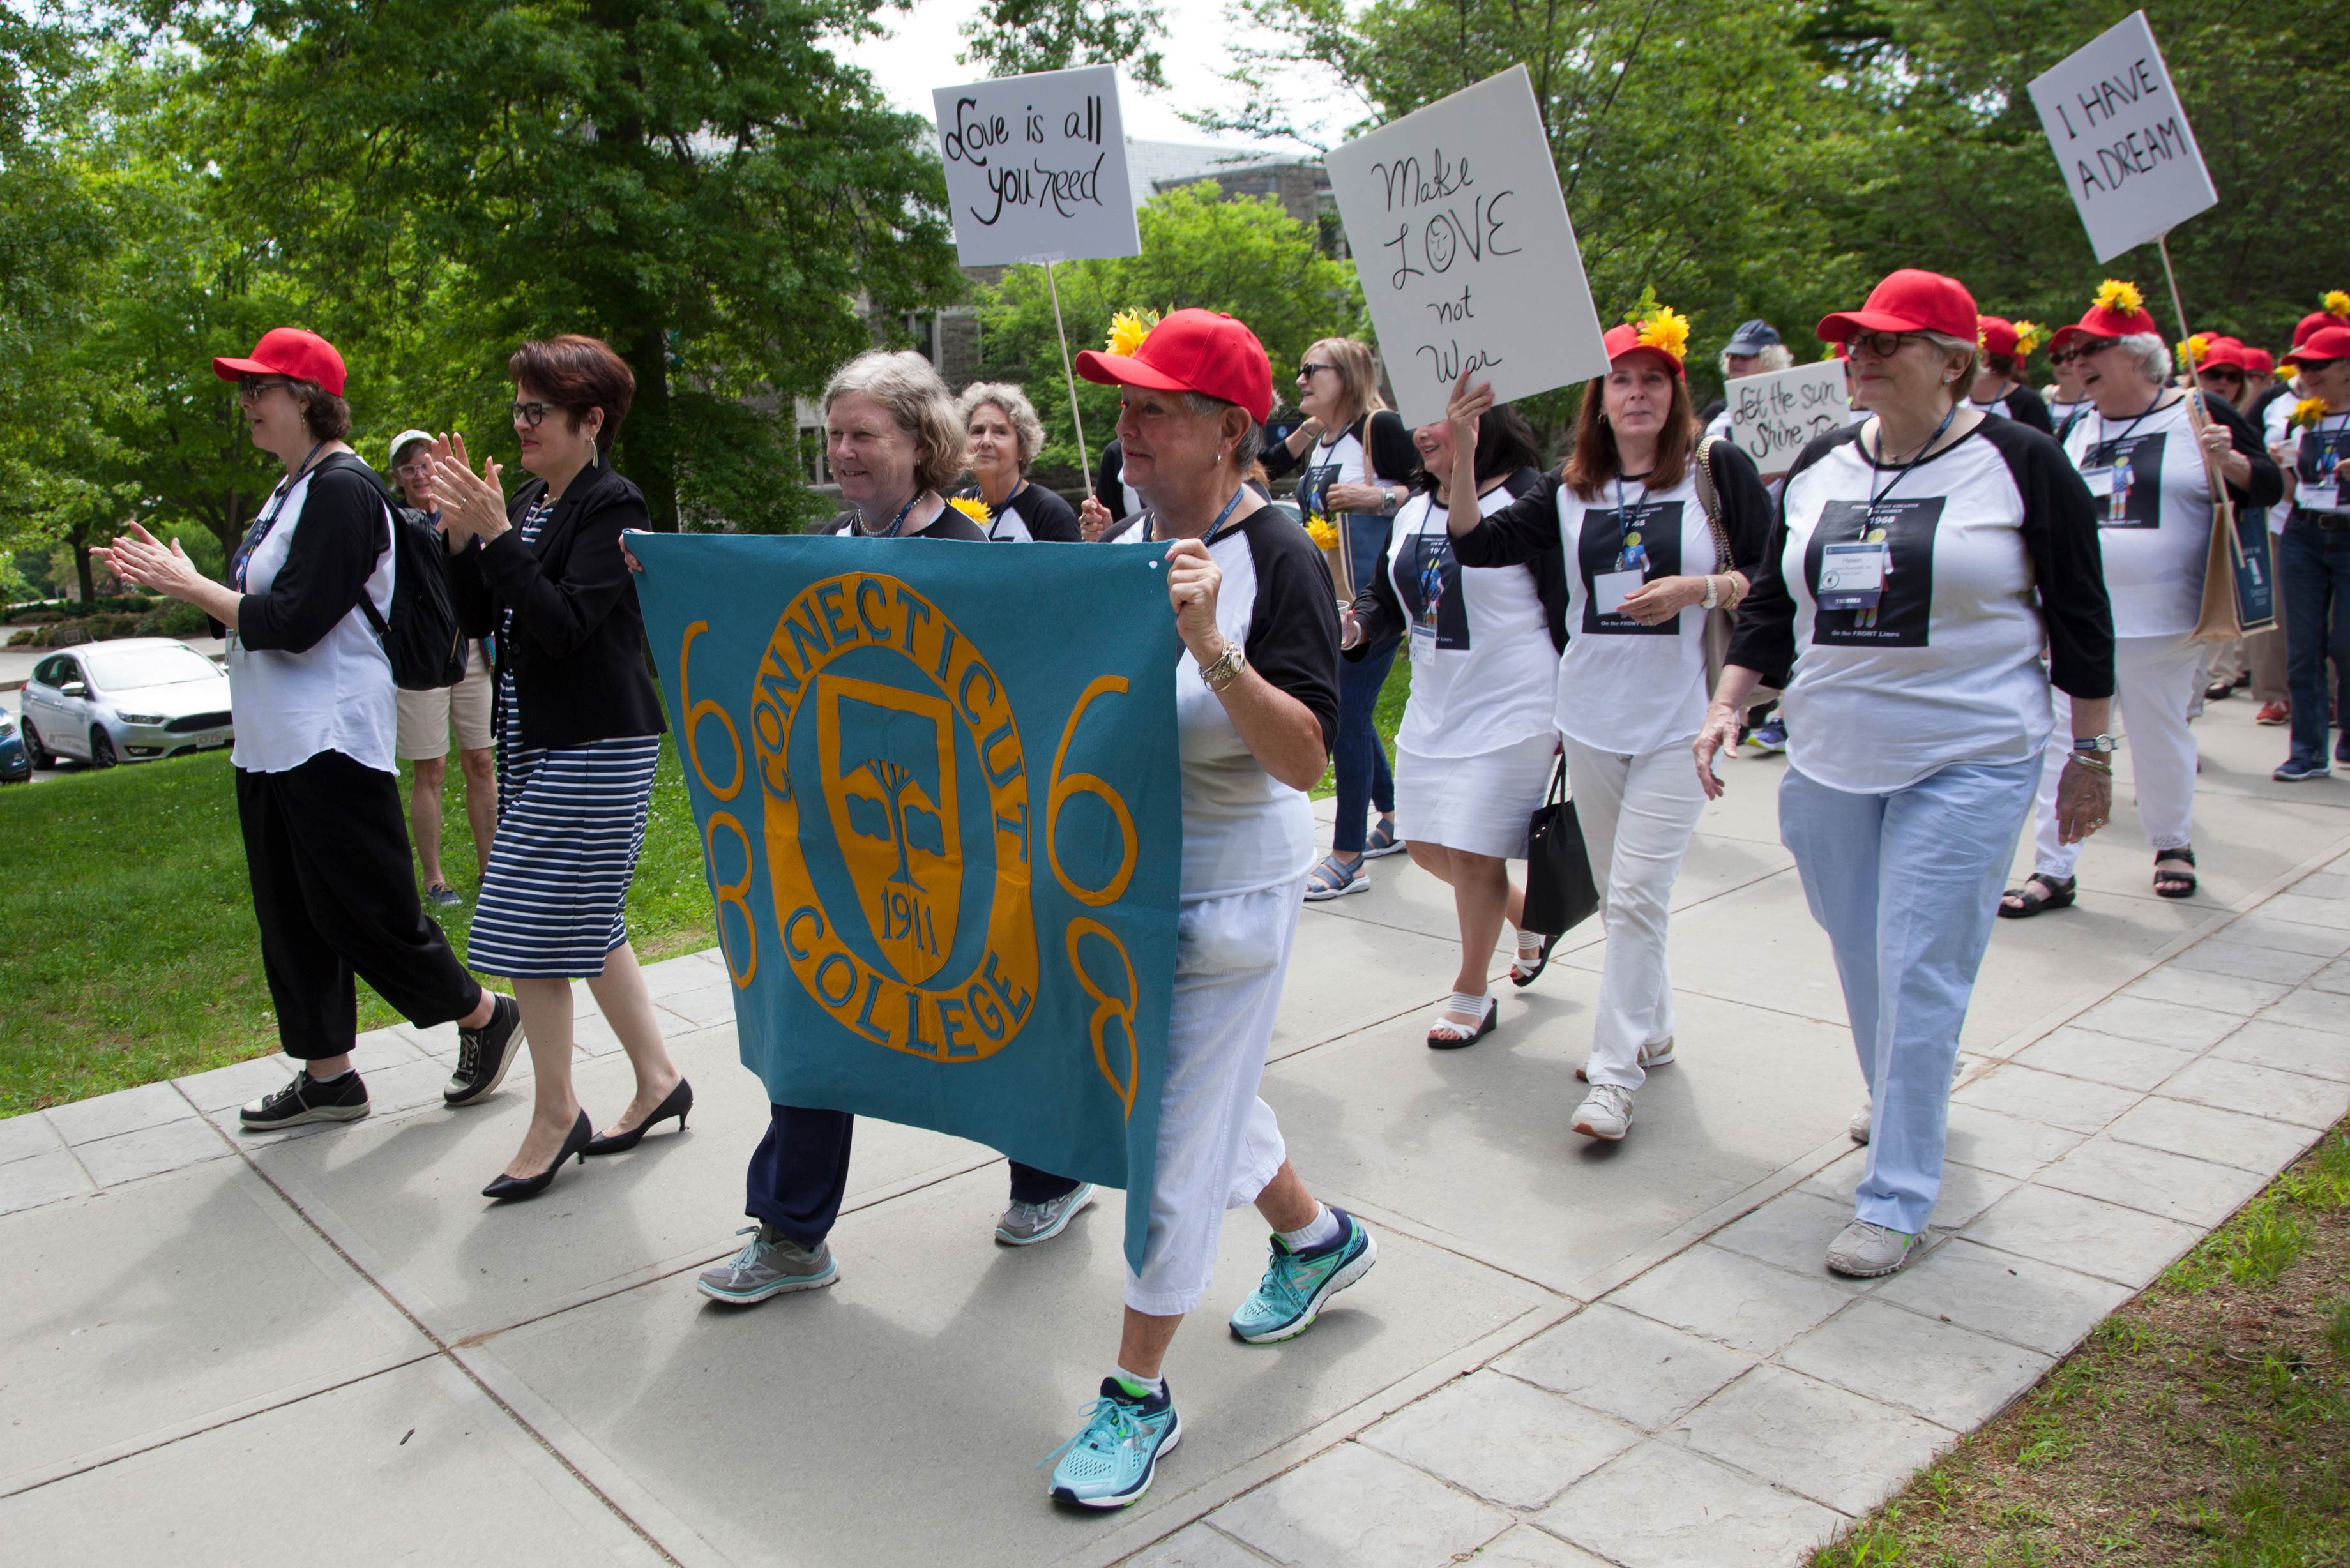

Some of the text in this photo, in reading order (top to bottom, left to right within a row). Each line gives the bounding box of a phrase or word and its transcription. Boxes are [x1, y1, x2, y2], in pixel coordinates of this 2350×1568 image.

[945, 95, 1102, 166] Love is all
[2056, 58, 2158, 140] I HAVE
[970, 151, 1105, 225] you need
[1371, 147, 1474, 213] Make
[2077, 116, 2187, 200] A DREAM
[1384, 190, 1523, 290] LOVE
[1426, 285, 1475, 324] not
[1416, 339, 1503, 384] War
[1734, 386, 1768, 426] Let
[1770, 380, 1798, 415] the
[1750, 419, 1805, 458] Shine
[1202, 522, 1220, 544] OLLEGE
[1625, 519, 1646, 528] 168
[1869, 516, 1896, 524] 1968
[754, 576, 1029, 864] CONNECTICUT
[880, 882, 940, 957] 1911
[784, 905, 1032, 1058] COLLEGE
